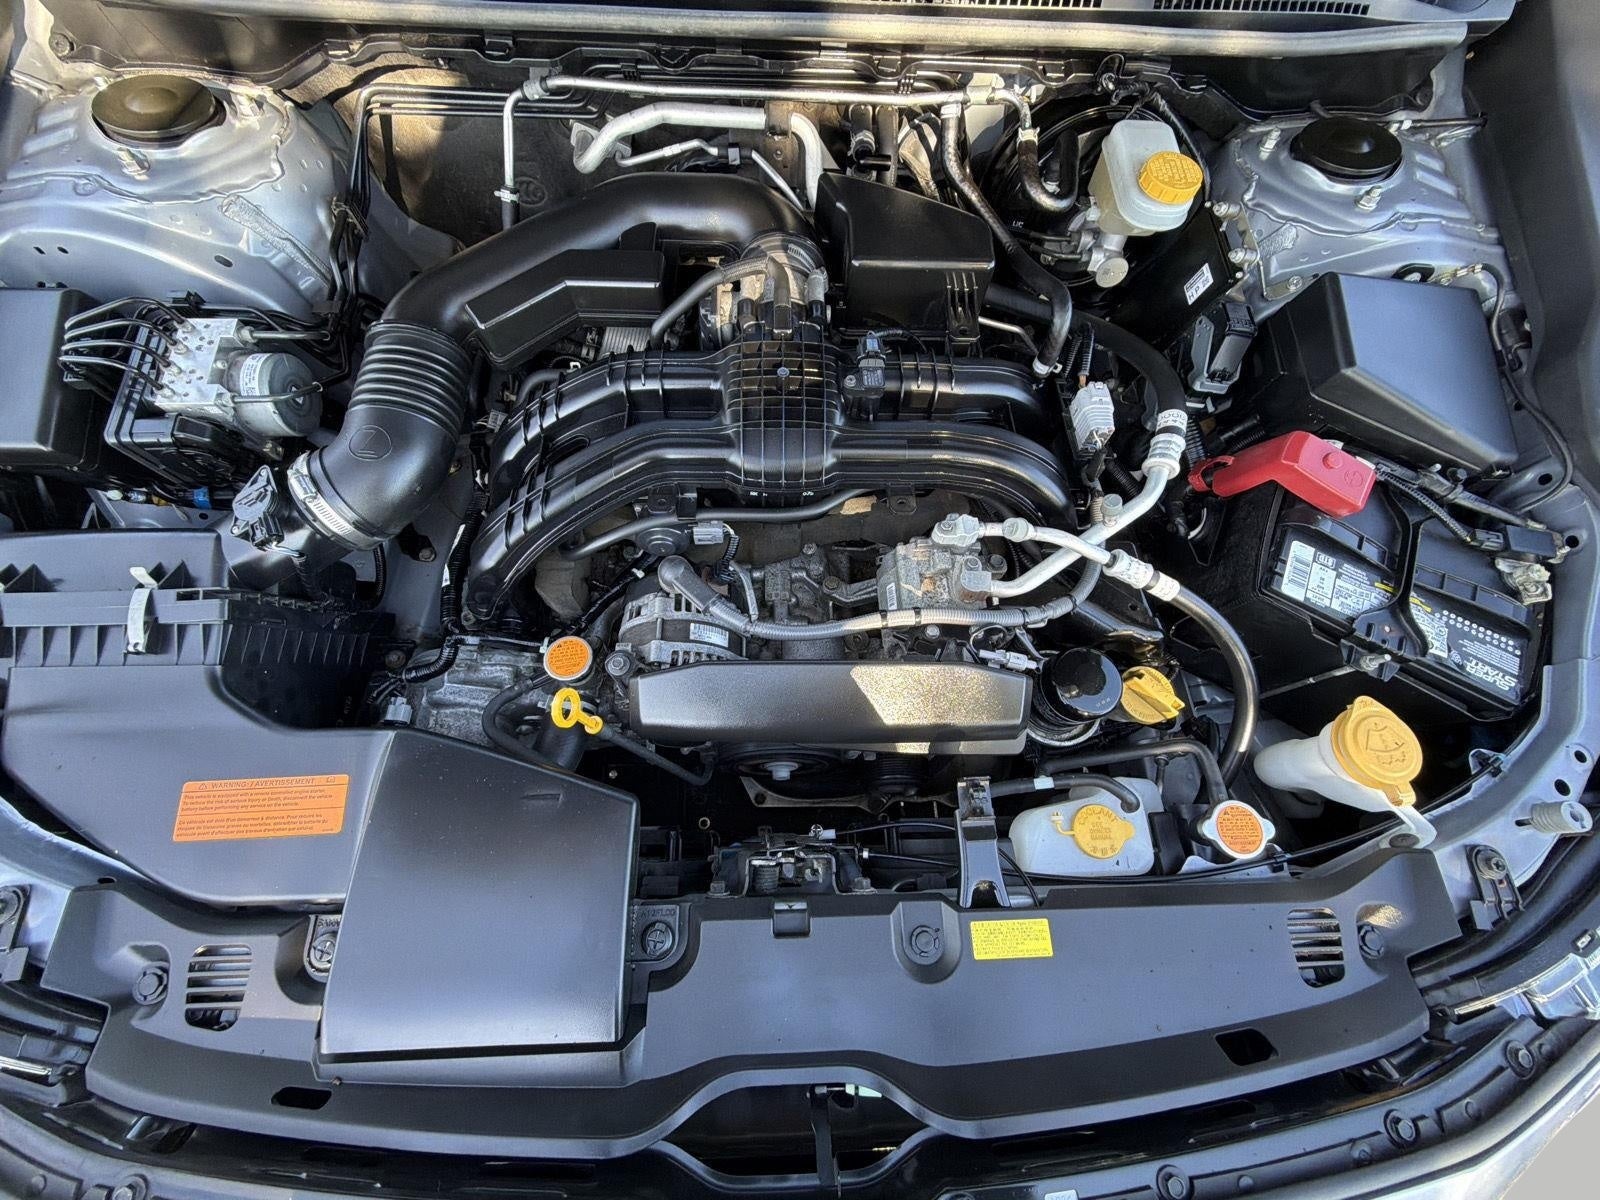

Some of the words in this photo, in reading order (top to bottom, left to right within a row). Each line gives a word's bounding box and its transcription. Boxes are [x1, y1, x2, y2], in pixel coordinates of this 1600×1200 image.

[1465, 657, 1518, 687] START
[1466, 663, 1509, 690] SUPER
[1078, 807, 1117, 826] COOLANT
